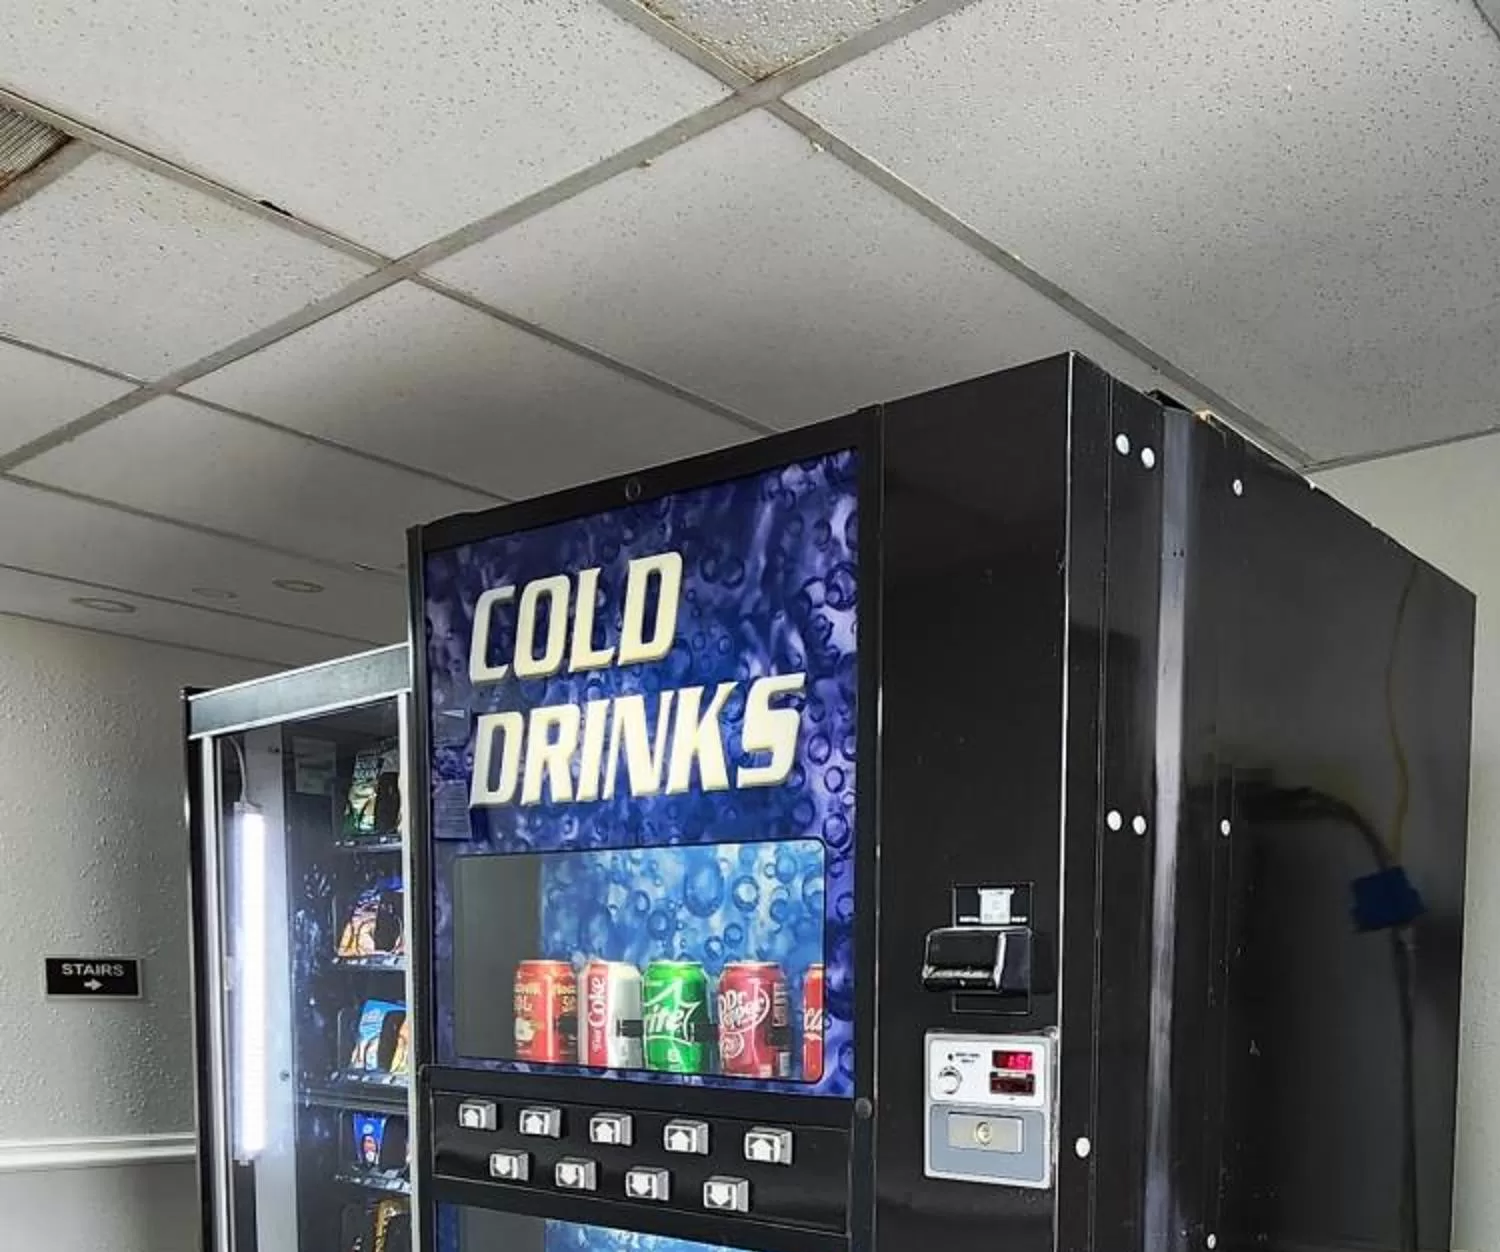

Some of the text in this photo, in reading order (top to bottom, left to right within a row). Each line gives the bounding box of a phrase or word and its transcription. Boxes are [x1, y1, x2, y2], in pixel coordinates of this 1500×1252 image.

[469, 551, 683, 685] COLD
[469, 672, 806, 808] DRINKS
[61, 963, 125, 976] STAIRS
[587, 977, 606, 1029] Coke
